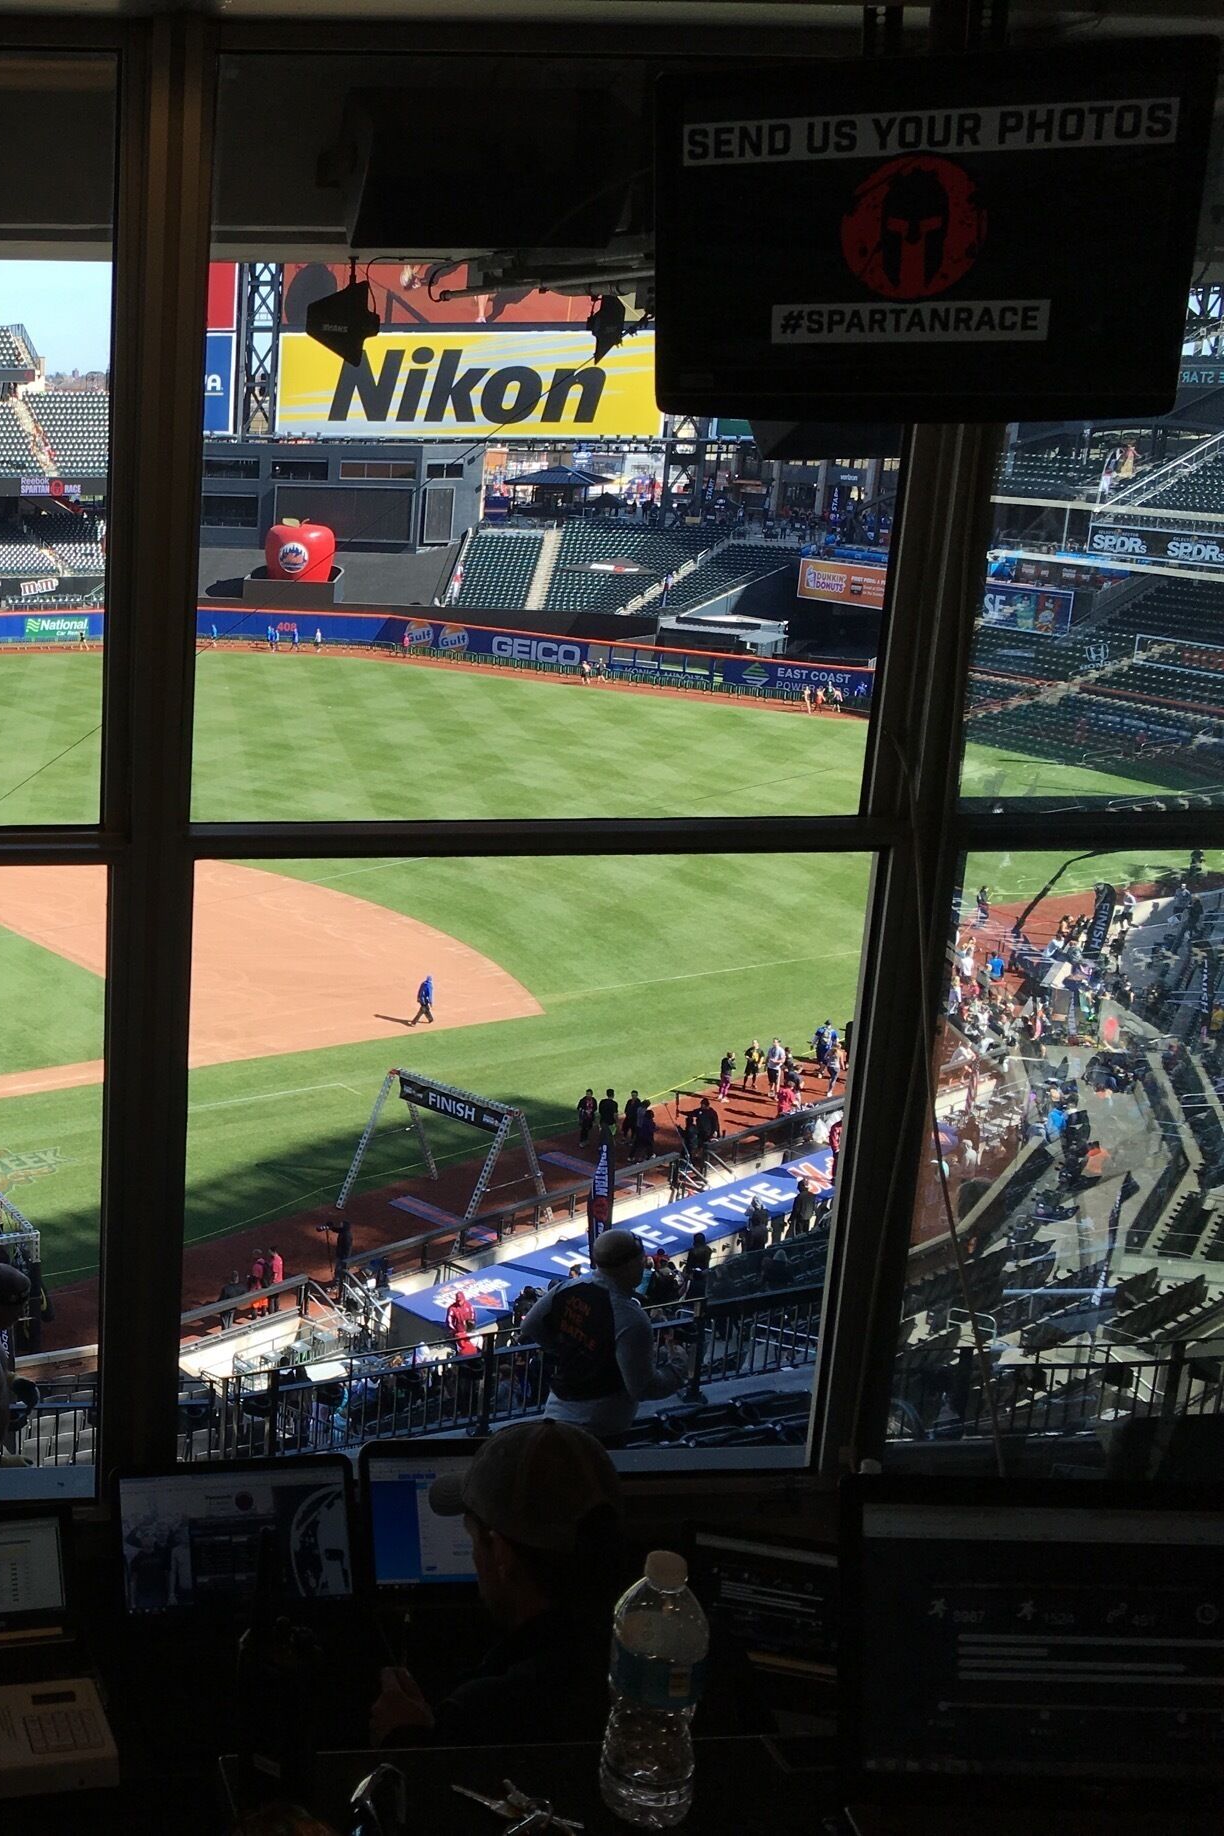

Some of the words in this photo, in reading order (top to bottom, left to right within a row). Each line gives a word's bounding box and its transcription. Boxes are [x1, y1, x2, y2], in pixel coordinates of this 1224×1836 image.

[687, 122, 791, 162] SEND
[806, 119, 859, 155] US
[872, 112, 983, 151] YOUR
[997, 101, 1173, 146] PHOTOS
[780, 304, 1041, 336] #SPARTANRACE
[328, 346, 607, 424] Nikon
[21, 476, 50, 486] Reebok
[21, 484, 50, 495] SPARTAN
[64, 485, 81, 494] RACE
[705, 477, 715, 500] START
[816, 581, 844, 592] DONUTS
[277, 622, 297, 632] 408
[407, 627, 432, 643] Gulf
[440, 633, 467, 648] Gulf
[492, 635, 580, 666] GEICO
[777, 667, 809, 679] EAST
[810, 669, 852, 684] COAST
[1089, 902, 1111, 951] FINISH
[428, 1091, 476, 1122] FINISH
[660, 1205, 720, 1235] OF
[707, 1181, 799, 1215] THE
